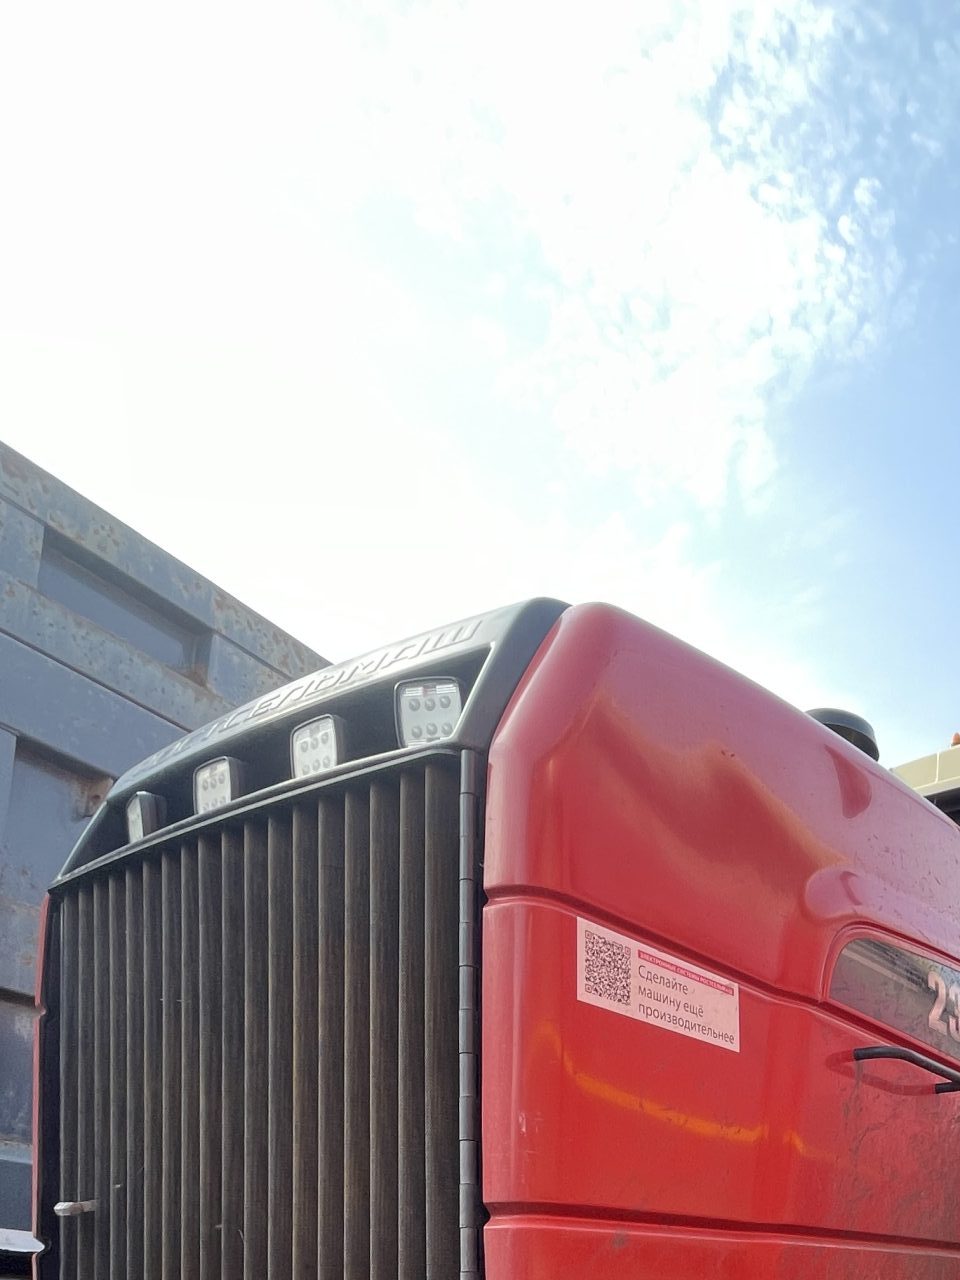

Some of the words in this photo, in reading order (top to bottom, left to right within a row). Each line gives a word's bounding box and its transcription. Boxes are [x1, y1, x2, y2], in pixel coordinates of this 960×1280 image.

[638, 965, 688, 995] Сделайте
[638, 985, 681, 1010] машину
[683, 1001, 704, 1018] ещё
[638, 1003, 735, 1044] производительнее
